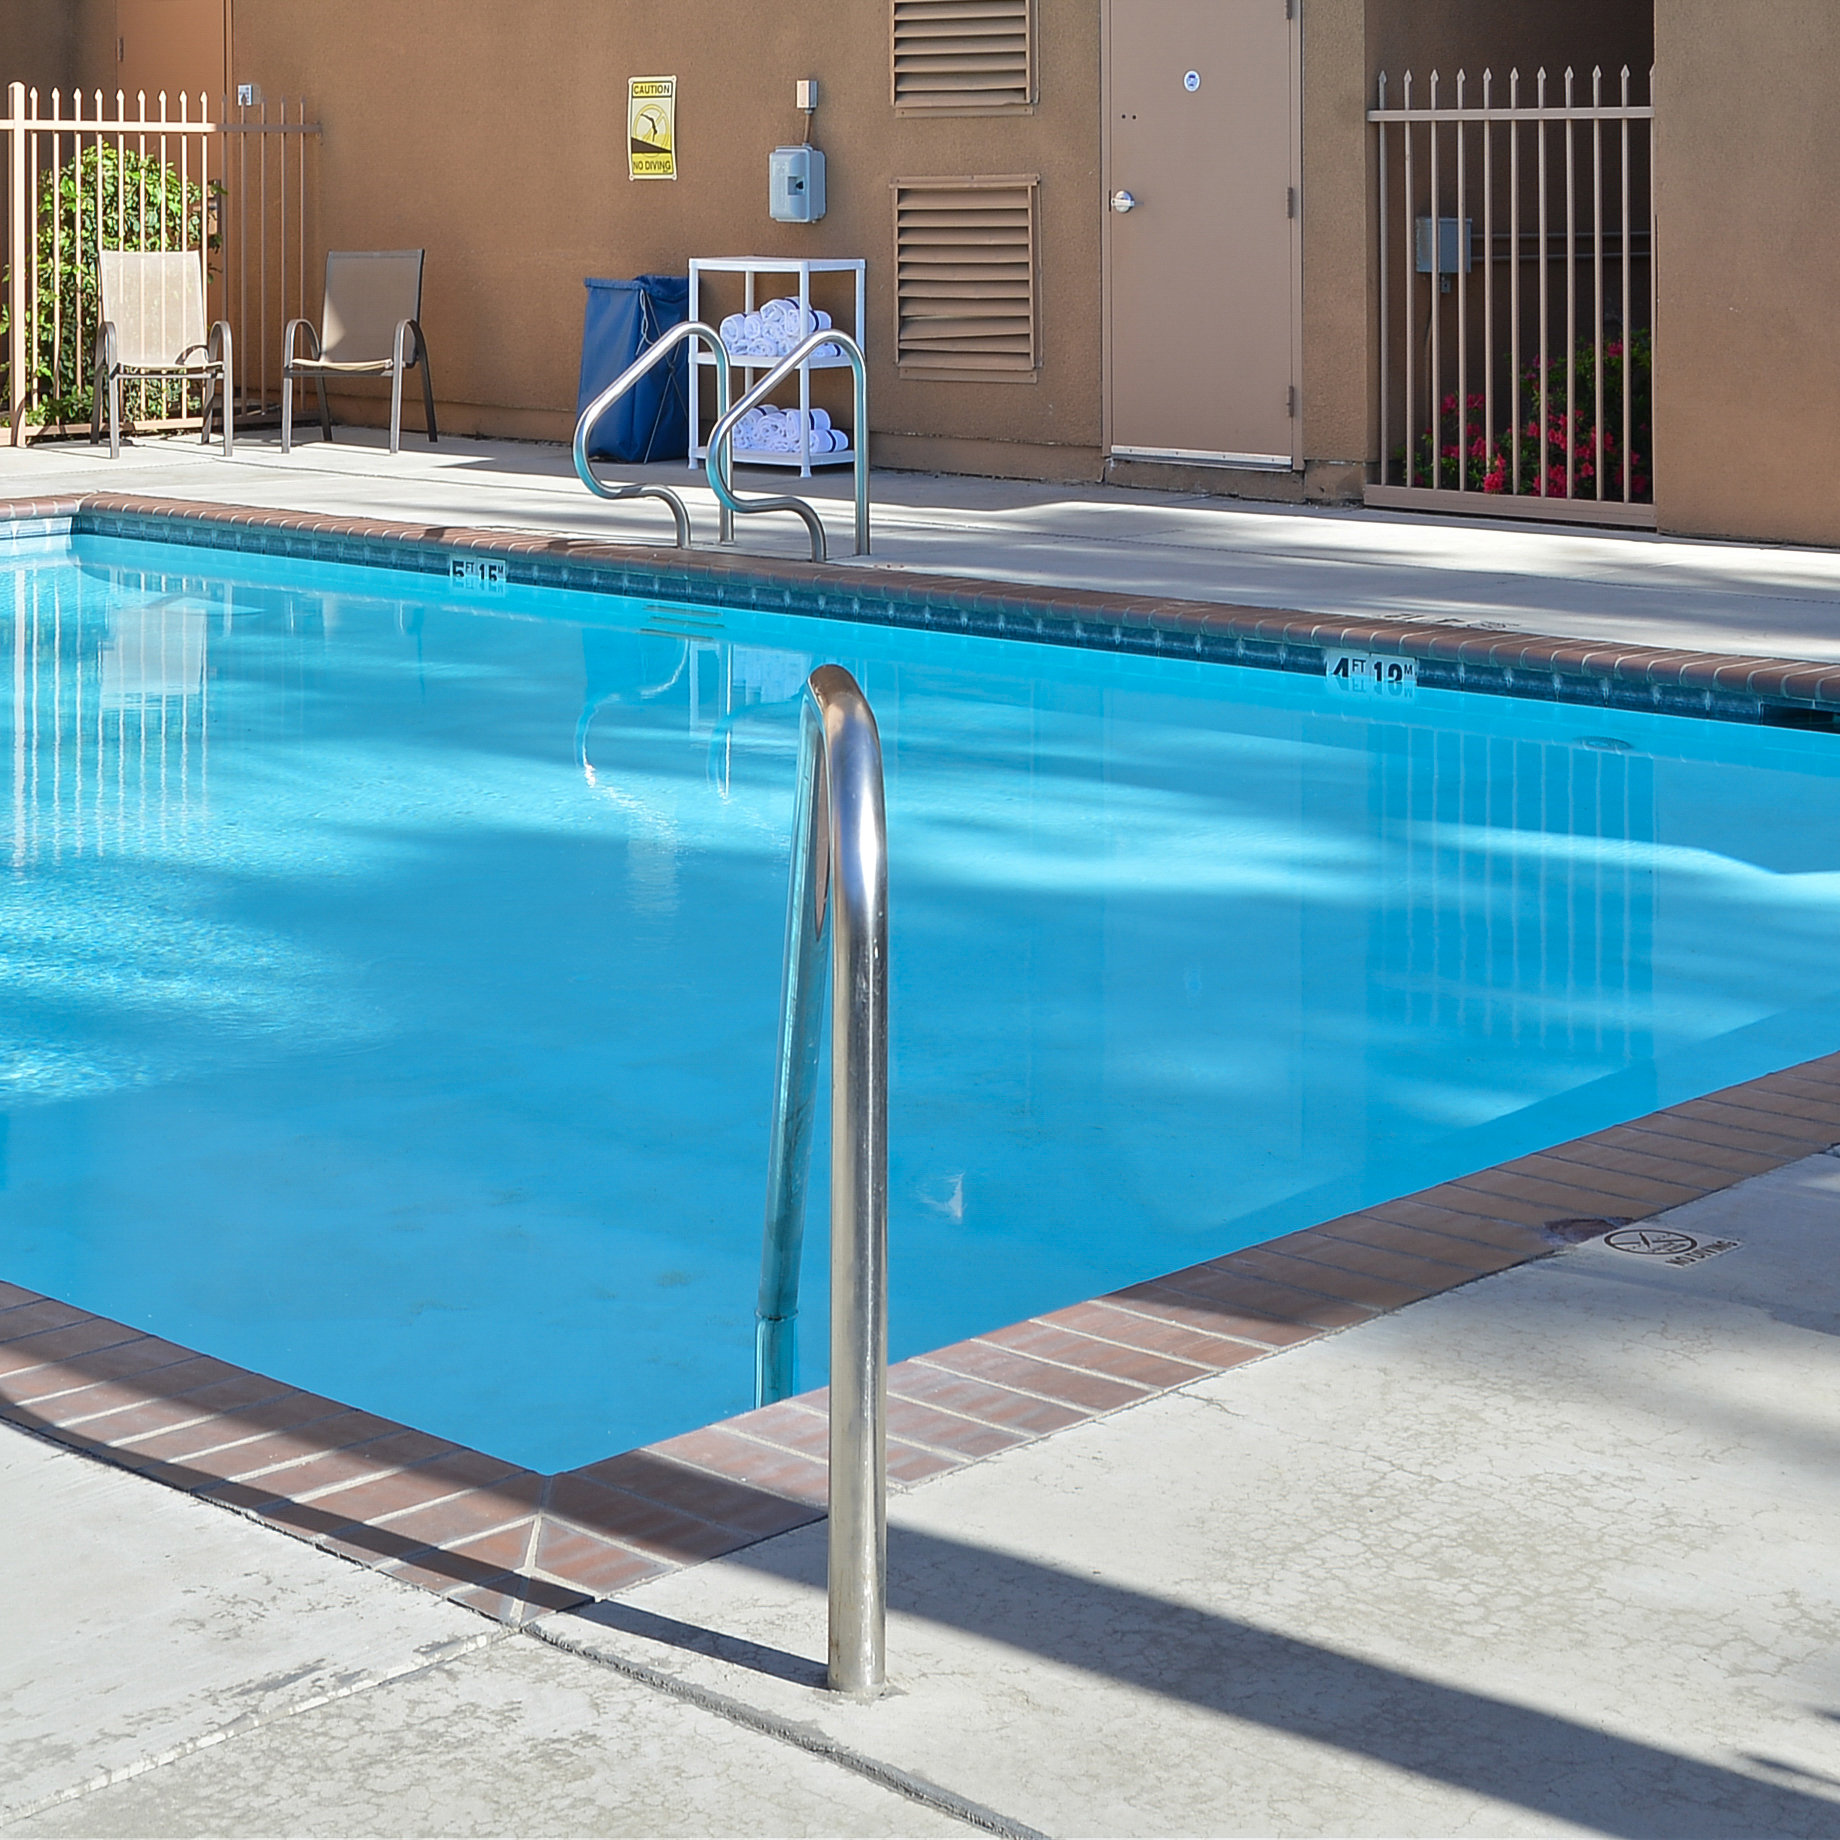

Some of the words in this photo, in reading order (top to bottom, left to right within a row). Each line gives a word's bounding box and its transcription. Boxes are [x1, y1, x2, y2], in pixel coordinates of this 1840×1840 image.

[633, 84, 670, 95] CAUTION
[633, 161, 644, 171] NO
[646, 160, 671, 171] DIVING
